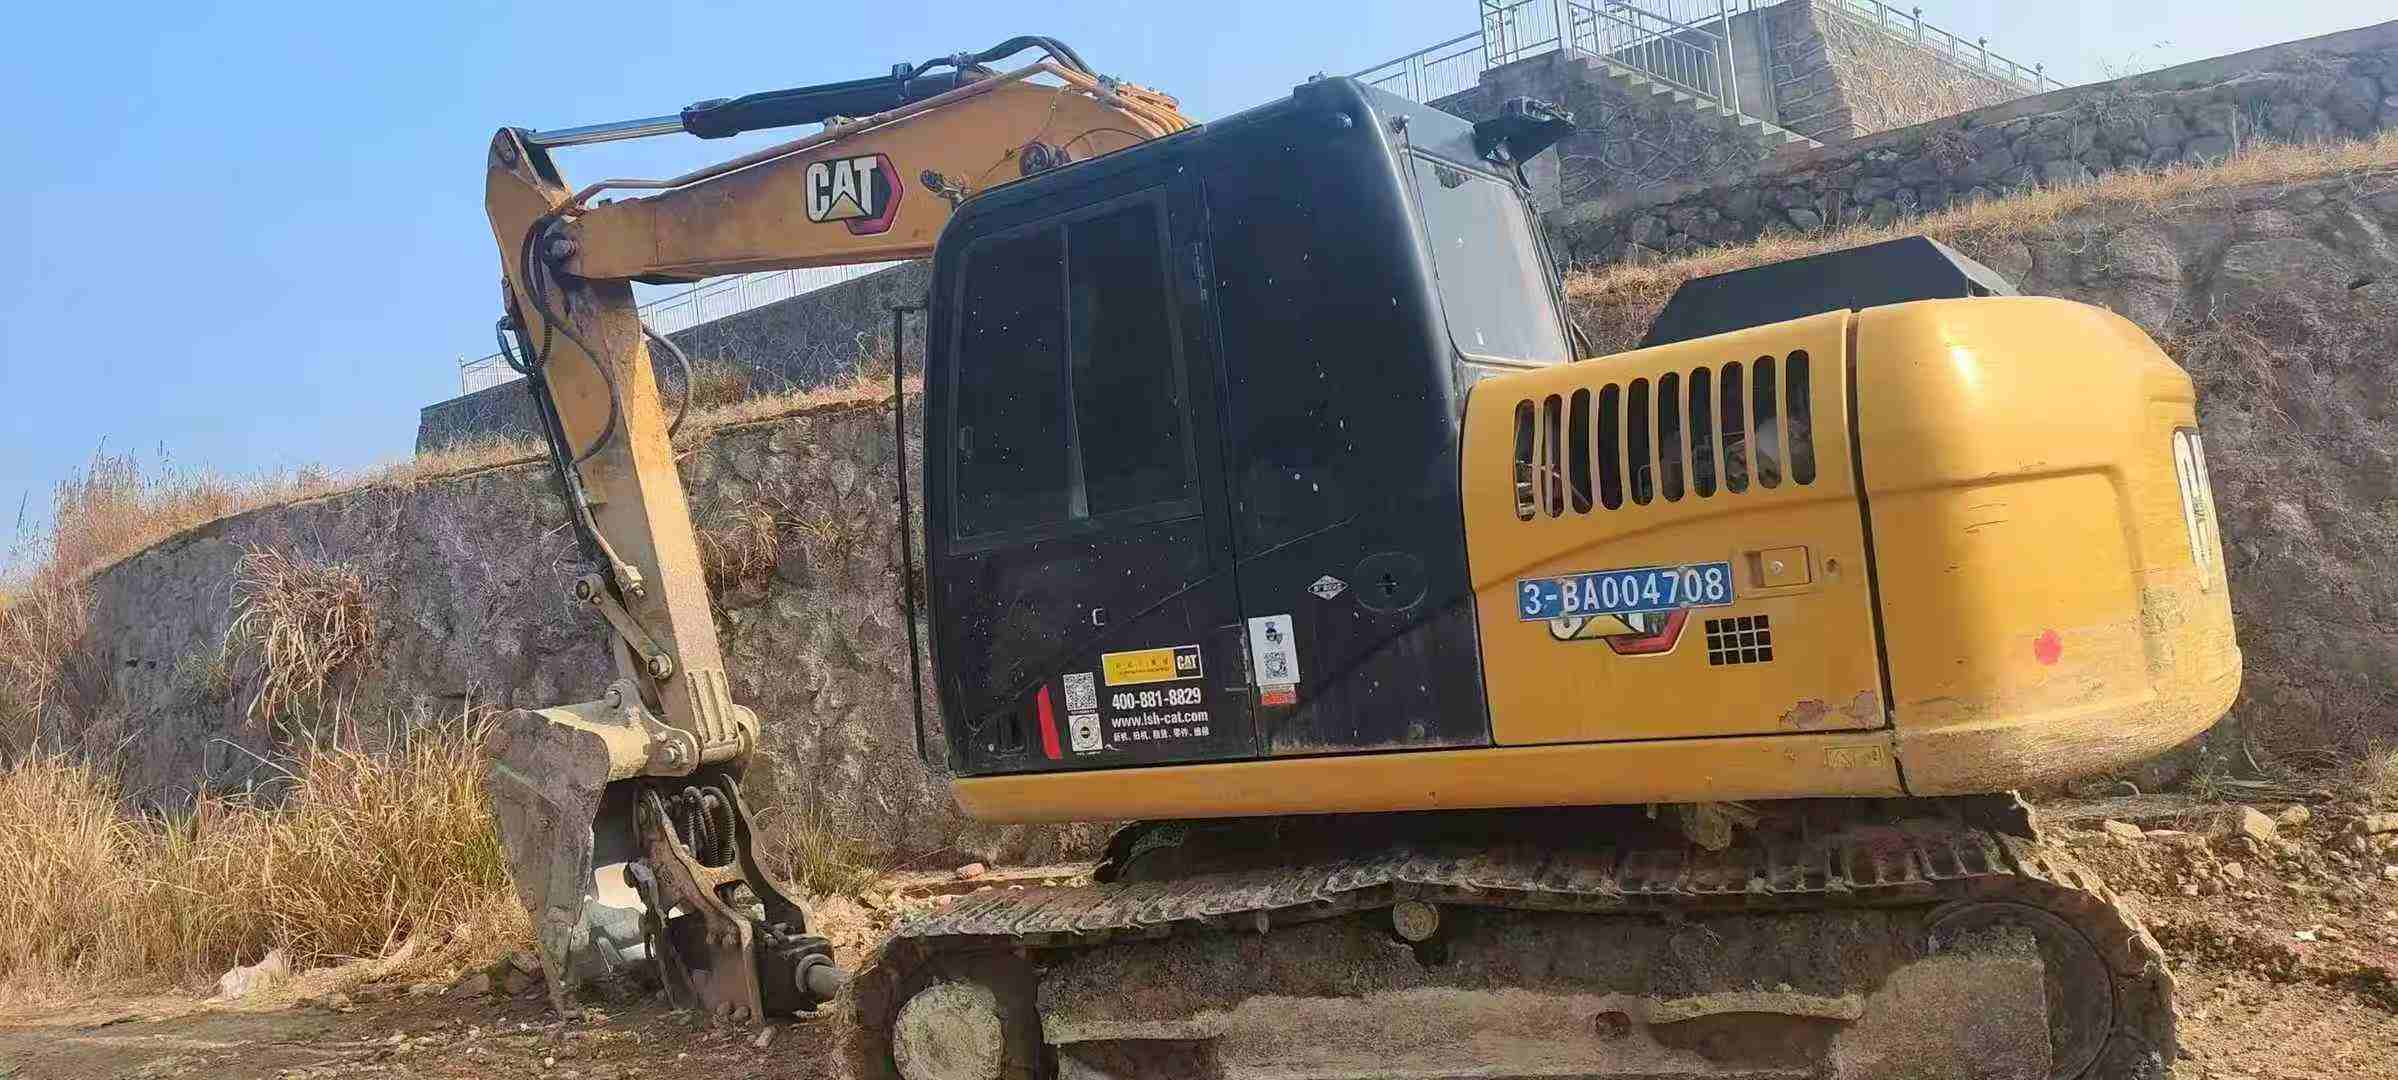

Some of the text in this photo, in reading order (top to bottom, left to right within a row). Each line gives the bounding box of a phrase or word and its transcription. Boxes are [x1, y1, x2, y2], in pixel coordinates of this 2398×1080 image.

[806, 155, 877, 221] CAT
[1523, 567, 1724, 616] 3-BA004708
[1176, 654, 1198, 671] CAT
[1111, 687, 1202, 711] 400-881-8829
[1111, 709, 1209, 729] www.lsh-cat.com
